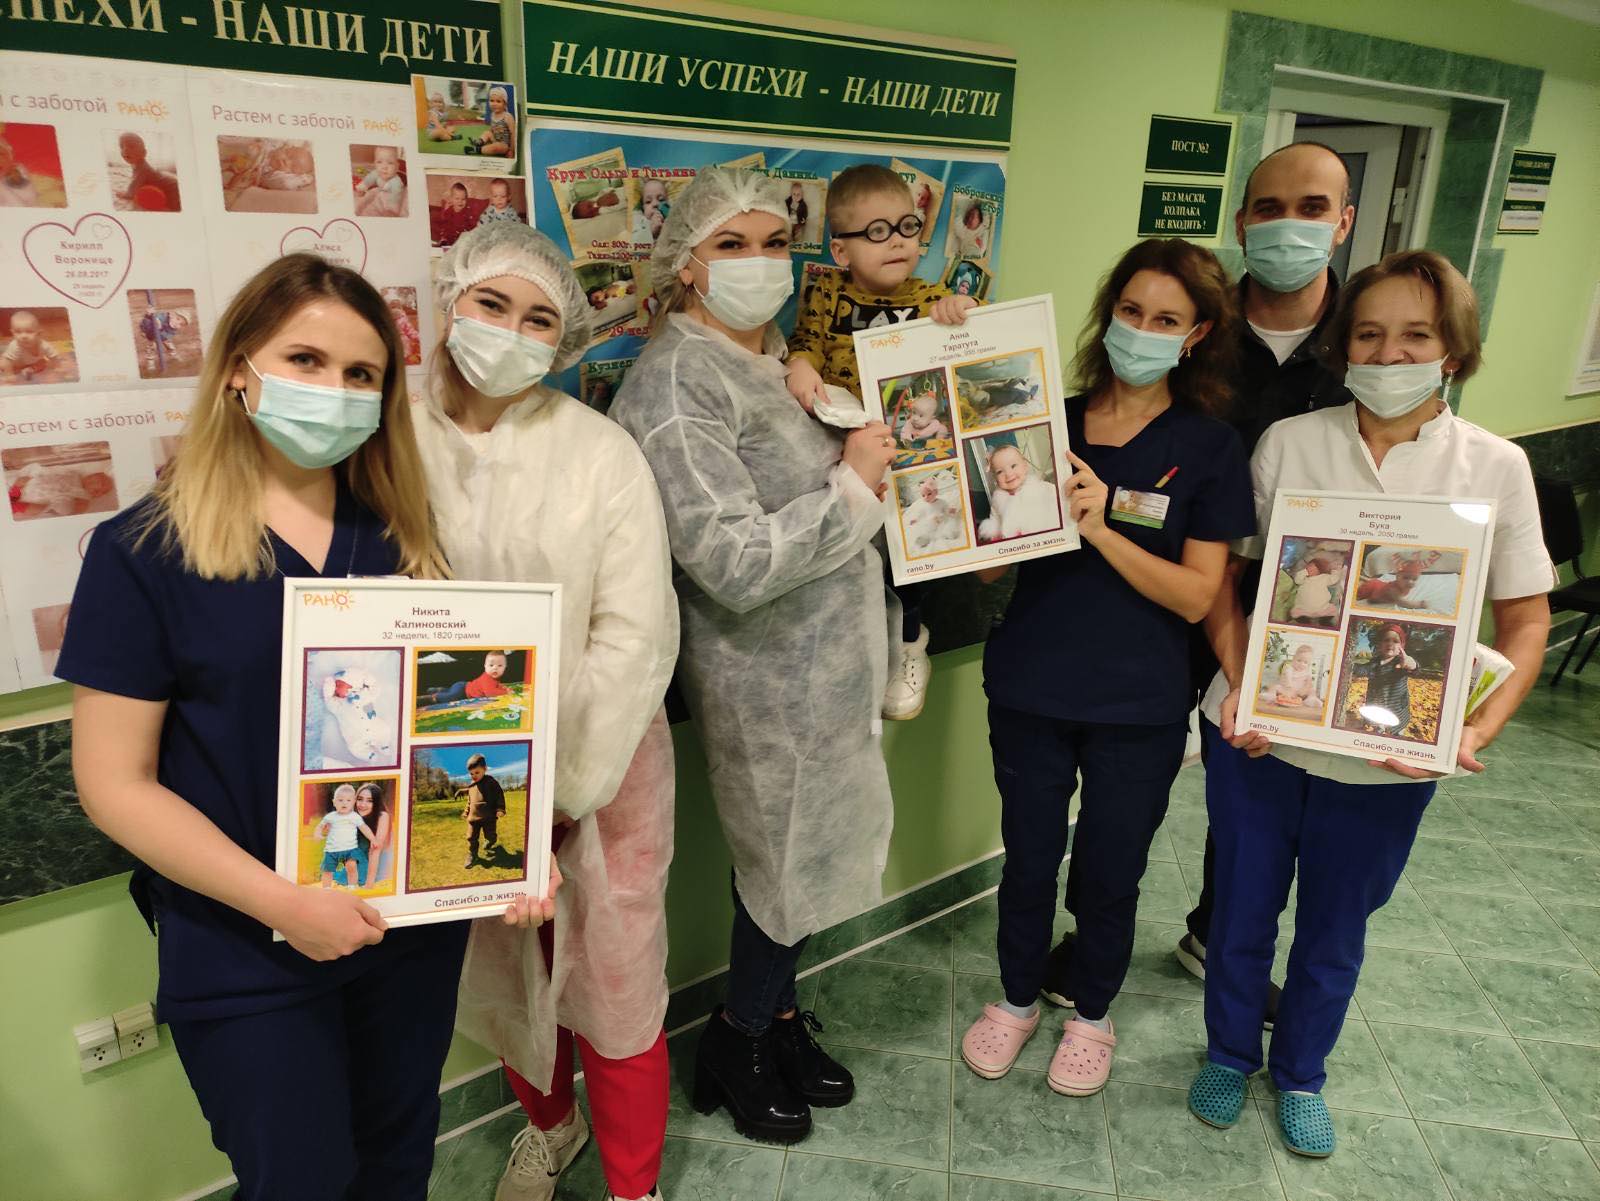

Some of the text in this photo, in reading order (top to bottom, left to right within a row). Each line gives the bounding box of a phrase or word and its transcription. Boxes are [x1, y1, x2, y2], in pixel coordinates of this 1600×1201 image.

[212, 0, 369, 54] НАШИ
[379, 18, 494, 68] ДЕТИ
[547, 40, 667, 83] НАШИ
[676, 56, 808, 98] УСПЕХИ
[841, 76, 930, 111] НАШИ
[930, 86, 1001, 119] ДЕТИ
[26, 93, 108, 115] заботой
[211, 104, 273, 125] Растем
[291, 114, 356, 131] заботой
[1171, 139, 1196, 153] ПОСТ
[641, 166, 697, 178] Татьяна
[1161, 191, 1176, 202] БЕЗ
[1154, 218, 1167, 229] НЕ
[836, 299, 914, 329] PLAY
[949, 331, 970, 341] Анна
[943, 340, 979, 352] Таратута
[85, 411, 156, 429] заботой
[1358, 511, 1402, 522] Виктория
[1368, 521, 1390, 530] Бука
[998, 537, 1066, 556] Спасибо за жизнь
[302, 589, 356, 611] РАНО
[412, 607, 451, 617] Никита
[394, 619, 467, 630] Калиновский
[382, 631, 480, 641] 32 недели, 1820 грамм
[1353, 737, 1437, 760] Спасибо за жизнь
[434, 895, 480, 908] Спасибо
[481, 893, 494, 902] за
